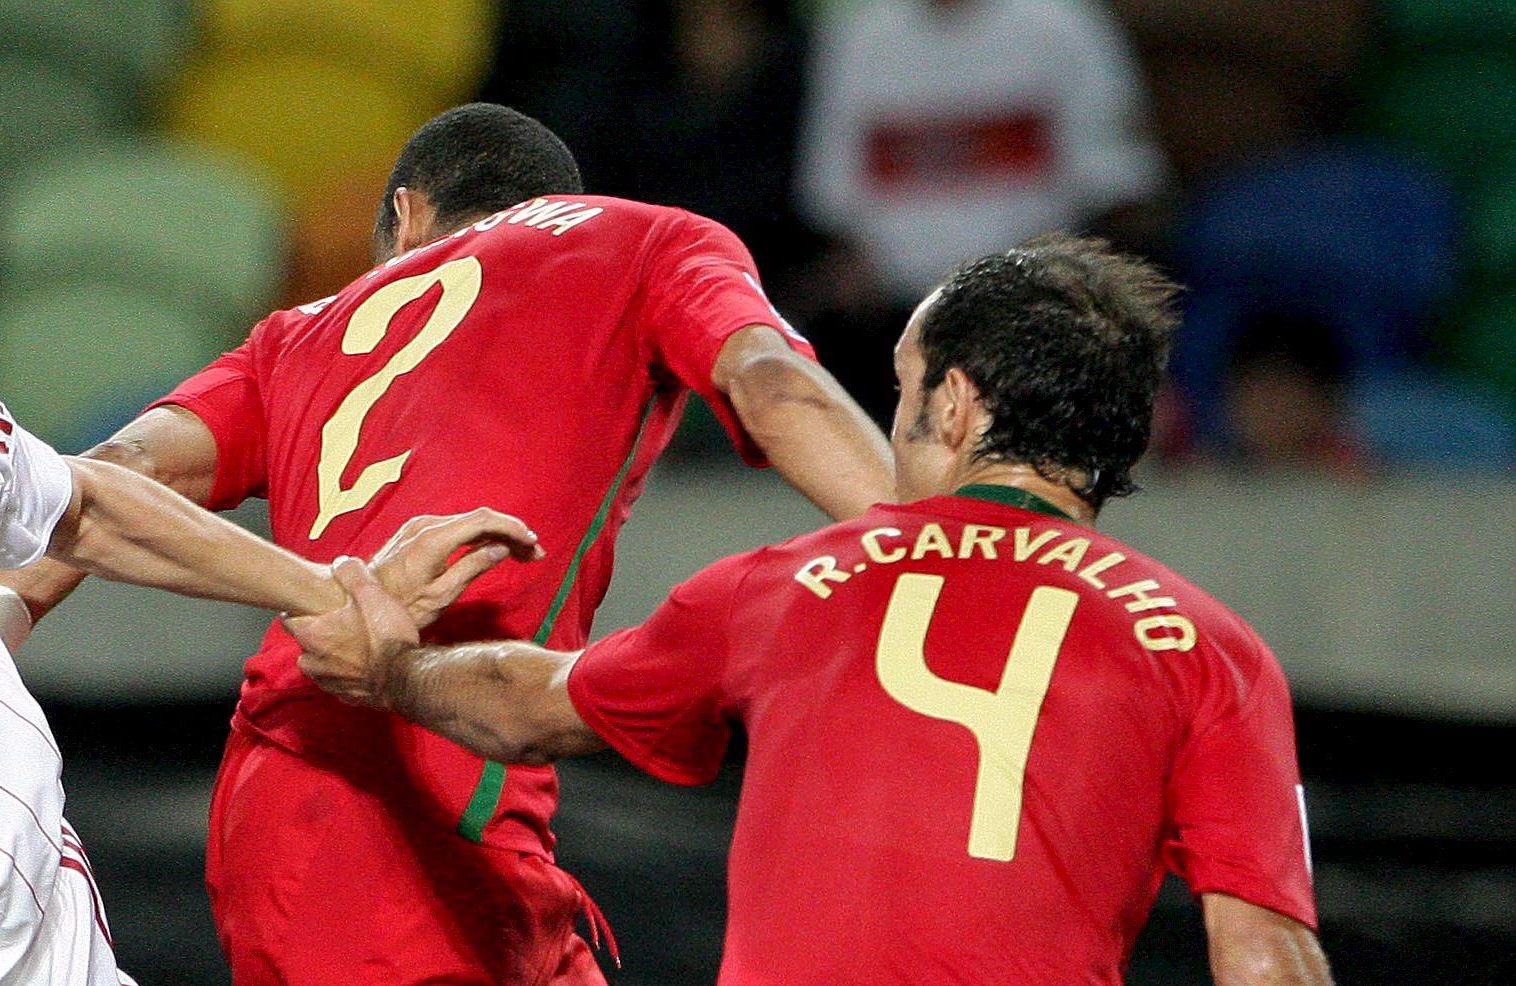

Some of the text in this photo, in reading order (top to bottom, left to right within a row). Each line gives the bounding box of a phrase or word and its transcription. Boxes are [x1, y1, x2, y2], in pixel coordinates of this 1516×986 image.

[309, 255, 483, 541] 2
[794, 522, 1198, 653] R.CARVALHO
[875, 572, 1080, 863] 4
